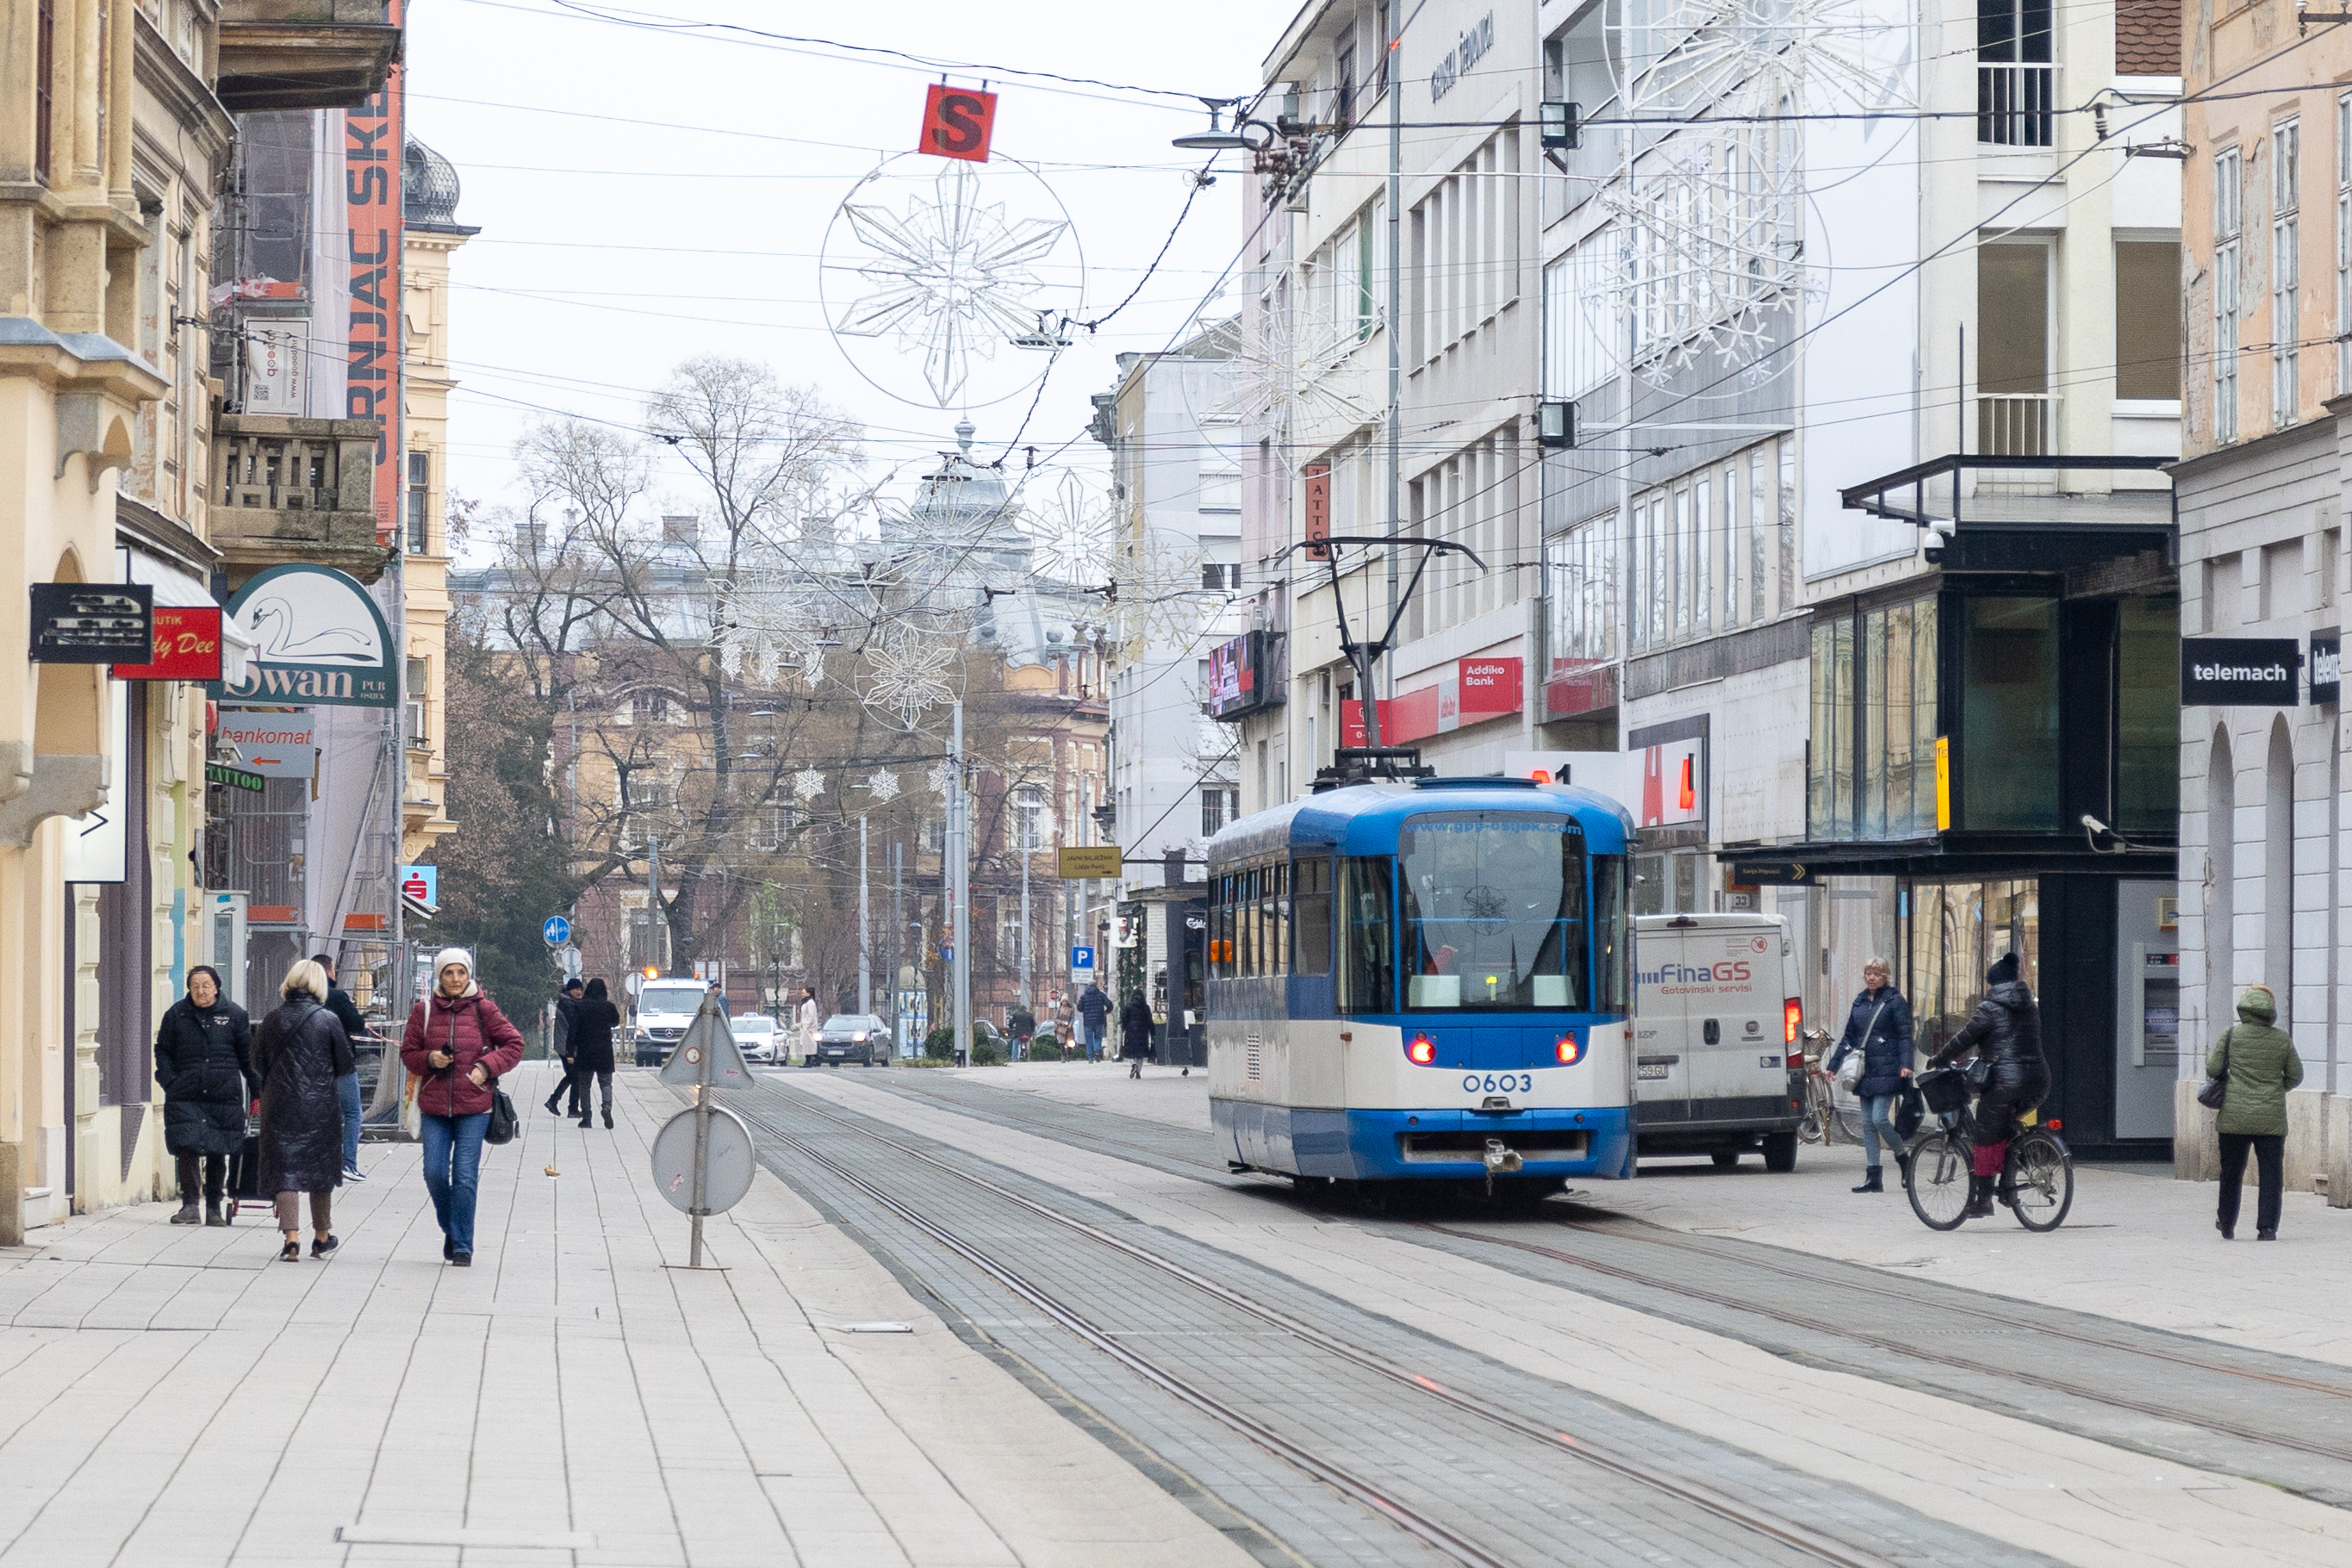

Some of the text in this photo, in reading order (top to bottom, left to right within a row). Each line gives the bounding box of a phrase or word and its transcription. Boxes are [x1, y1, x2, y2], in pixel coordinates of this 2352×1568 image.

[931, 94, 984, 152] S
[1312, 469, 1324, 556] TATTO
[177, 632, 215, 654] Dee
[224, 644, 355, 698] Swan
[1466, 665, 1505, 675] Addiko
[2194, 663, 2287, 681] telemach
[362, 681, 385, 691] PUB
[1466, 676, 1494, 686] Bank
[222, 727, 312, 745] bankomat
[208, 765, 262, 790] TATTOO
[1735, 895, 1747, 906] 33
[1078, 951, 1088, 964] P
[1661, 961, 1751, 984] FinaGS
[1661, 984, 1752, 995] Gotovinski servisi
[1463, 1074, 1532, 1093] 0603
